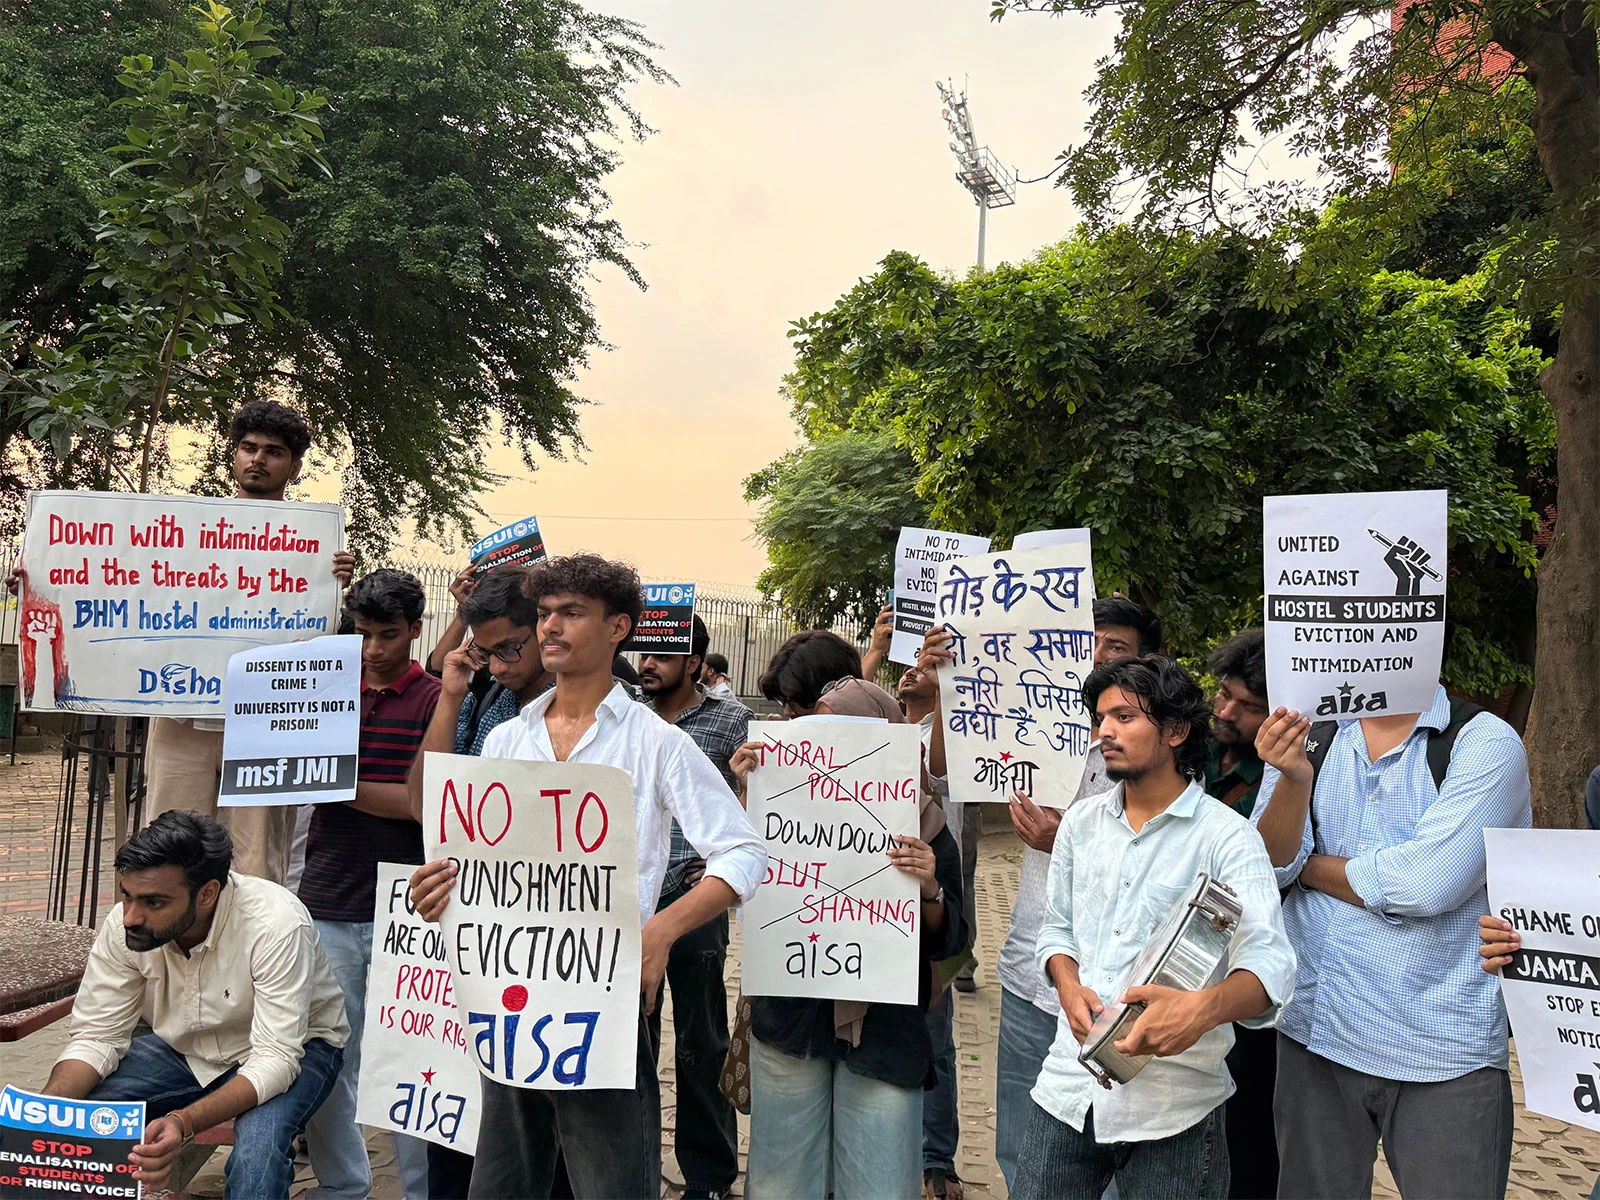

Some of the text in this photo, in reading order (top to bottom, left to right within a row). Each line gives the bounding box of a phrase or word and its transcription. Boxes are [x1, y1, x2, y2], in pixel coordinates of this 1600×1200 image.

[49, 513, 320, 554] Down with intimidation
[471, 528, 513, 558] NSUI
[925, 535, 960, 550] NO TO
[1278, 536, 1340, 553] UNITED
[489, 544, 520, 560] STOP
[49, 558, 309, 598] and the threats by the
[921, 567, 935, 579] NO
[992, 558, 1028, 613] के
[1030, 567, 1086, 613] रख
[1278, 569, 1360, 587] AGAINST
[73, 599, 328, 633] BHM hostel administration
[1274, 600, 1436, 619] HOSTEL STUDENTS
[662, 635, 690, 643] VOICE
[1294, 627, 1418, 643] EVICTION AND
[245, 660, 343, 674] DISSENT IS NOT A
[1291, 656, 1413, 673] INTIMIDATION
[271, 678, 308, 690] CRIME
[952, 666, 1004, 709] नारी
[1315, 681, 1388, 716] aisa
[234, 700, 356, 716] UNIVERSITY IS NOT A
[270, 718, 319, 732] PRISON!
[760, 739, 848, 771] MORAL
[236, 756, 339, 788] msf JMI
[808, 772, 917, 804] POLICING
[439, 778, 609, 854] NO TO
[765, 812, 834, 848] DOWN
[797, 894, 915, 933] SHAMING
[1500, 907, 1575, 936] SHAME
[384, 920, 448, 962] ARE OU
[785, 931, 863, 980] aisa
[457, 922, 621, 993] EVICTION!
[1516, 954, 1600, 986] JAMIA
[396, 964, 457, 1008] PROTE
[1547, 995, 1584, 1014] STOP
[379, 1005, 468, 1055] IS OUR RIG
[468, 984, 601, 1088] aisa
[0, 1092, 86, 1130] NSUI
[389, 1066, 467, 1144] aisa
[32, 1139, 93, 1157] STOP
[18, 1166, 105, 1184] STUDENTS
[115, 1164, 138, 1174] OF
[25, 1178, 82, 1193] RISING
[84, 1184, 136, 1198] VOICE
